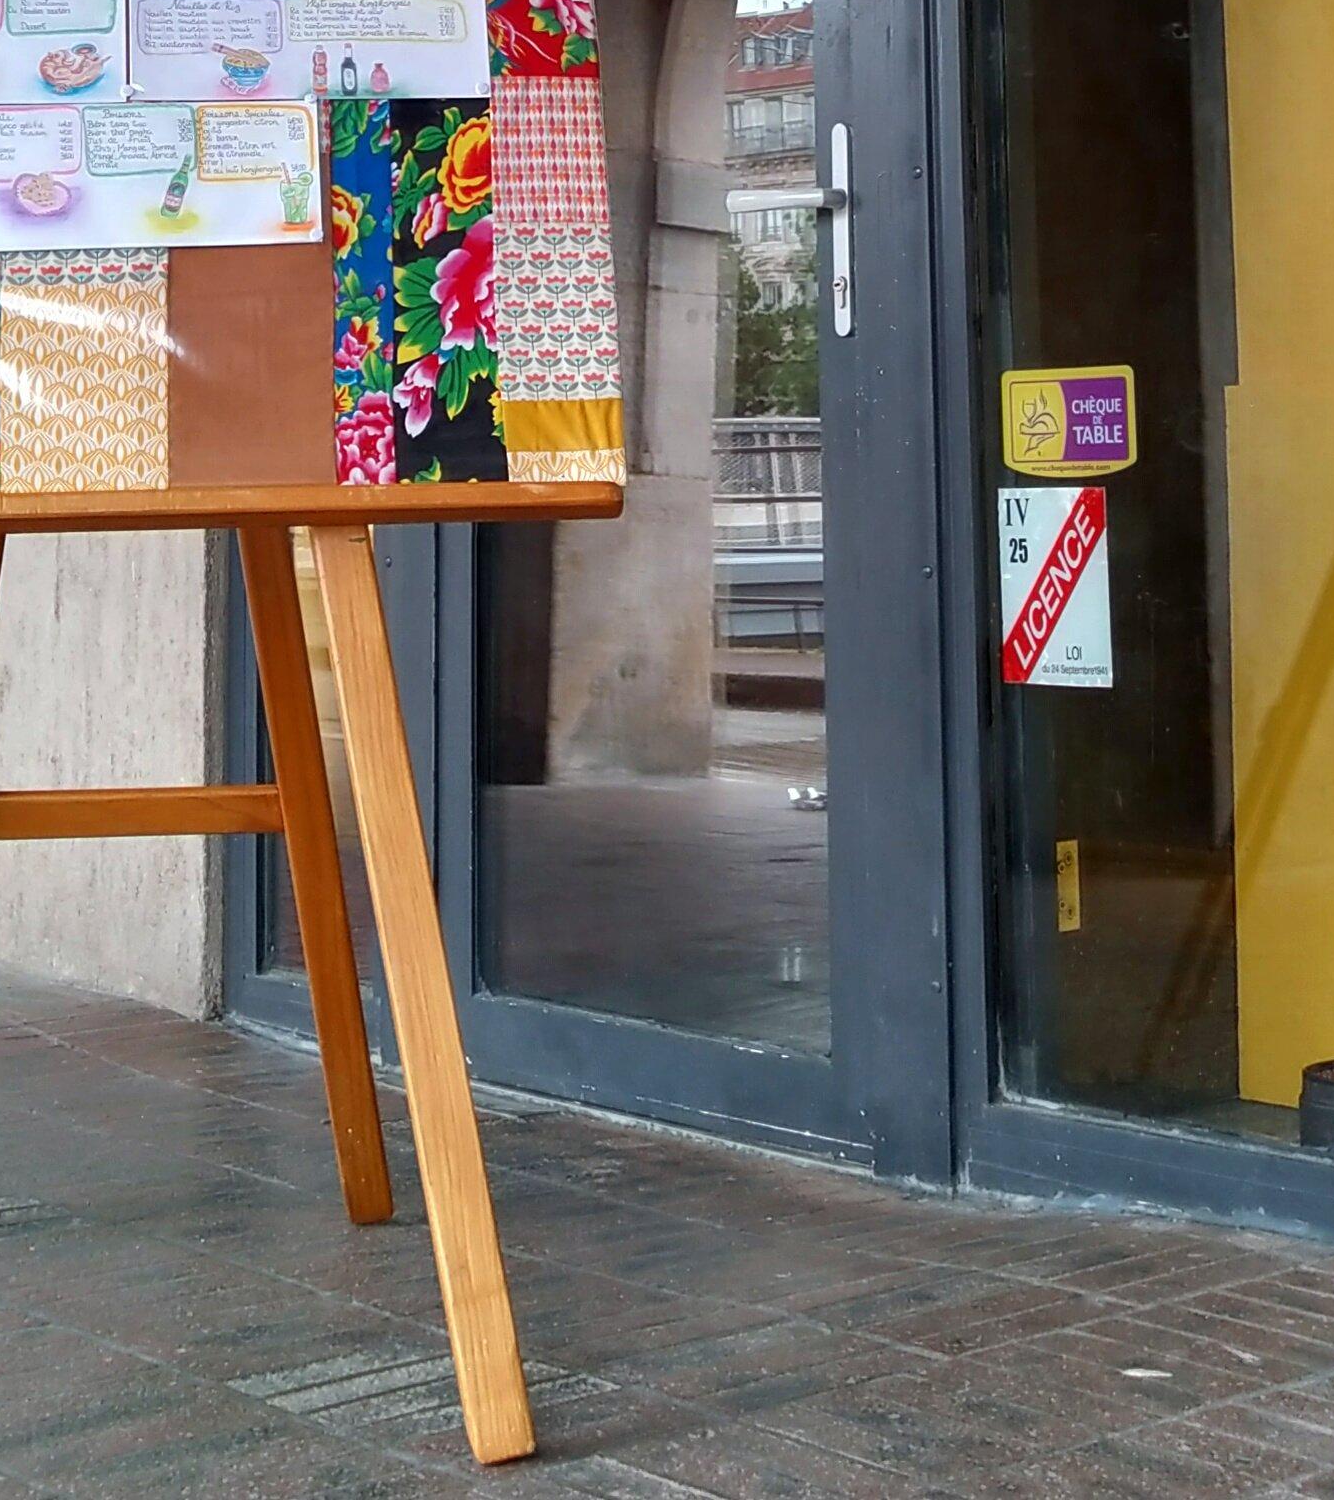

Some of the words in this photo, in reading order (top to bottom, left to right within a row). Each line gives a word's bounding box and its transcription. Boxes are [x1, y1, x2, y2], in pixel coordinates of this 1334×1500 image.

[1071, 396, 1123, 415] CHÈQUE
[1092, 415, 1103, 425] DE
[1072, 425, 1124, 445] TABLE
[1004, 498, 1030, 527] IV
[1009, 538, 1029, 564] 25
[1013, 503, 1096, 671] LICENCE
[1066, 645, 1083, 661] LOI
[1041, 664, 1050, 673] du
[1051, 664, 1059, 674] 24
[1060, 664, 1094, 676] Septembre
